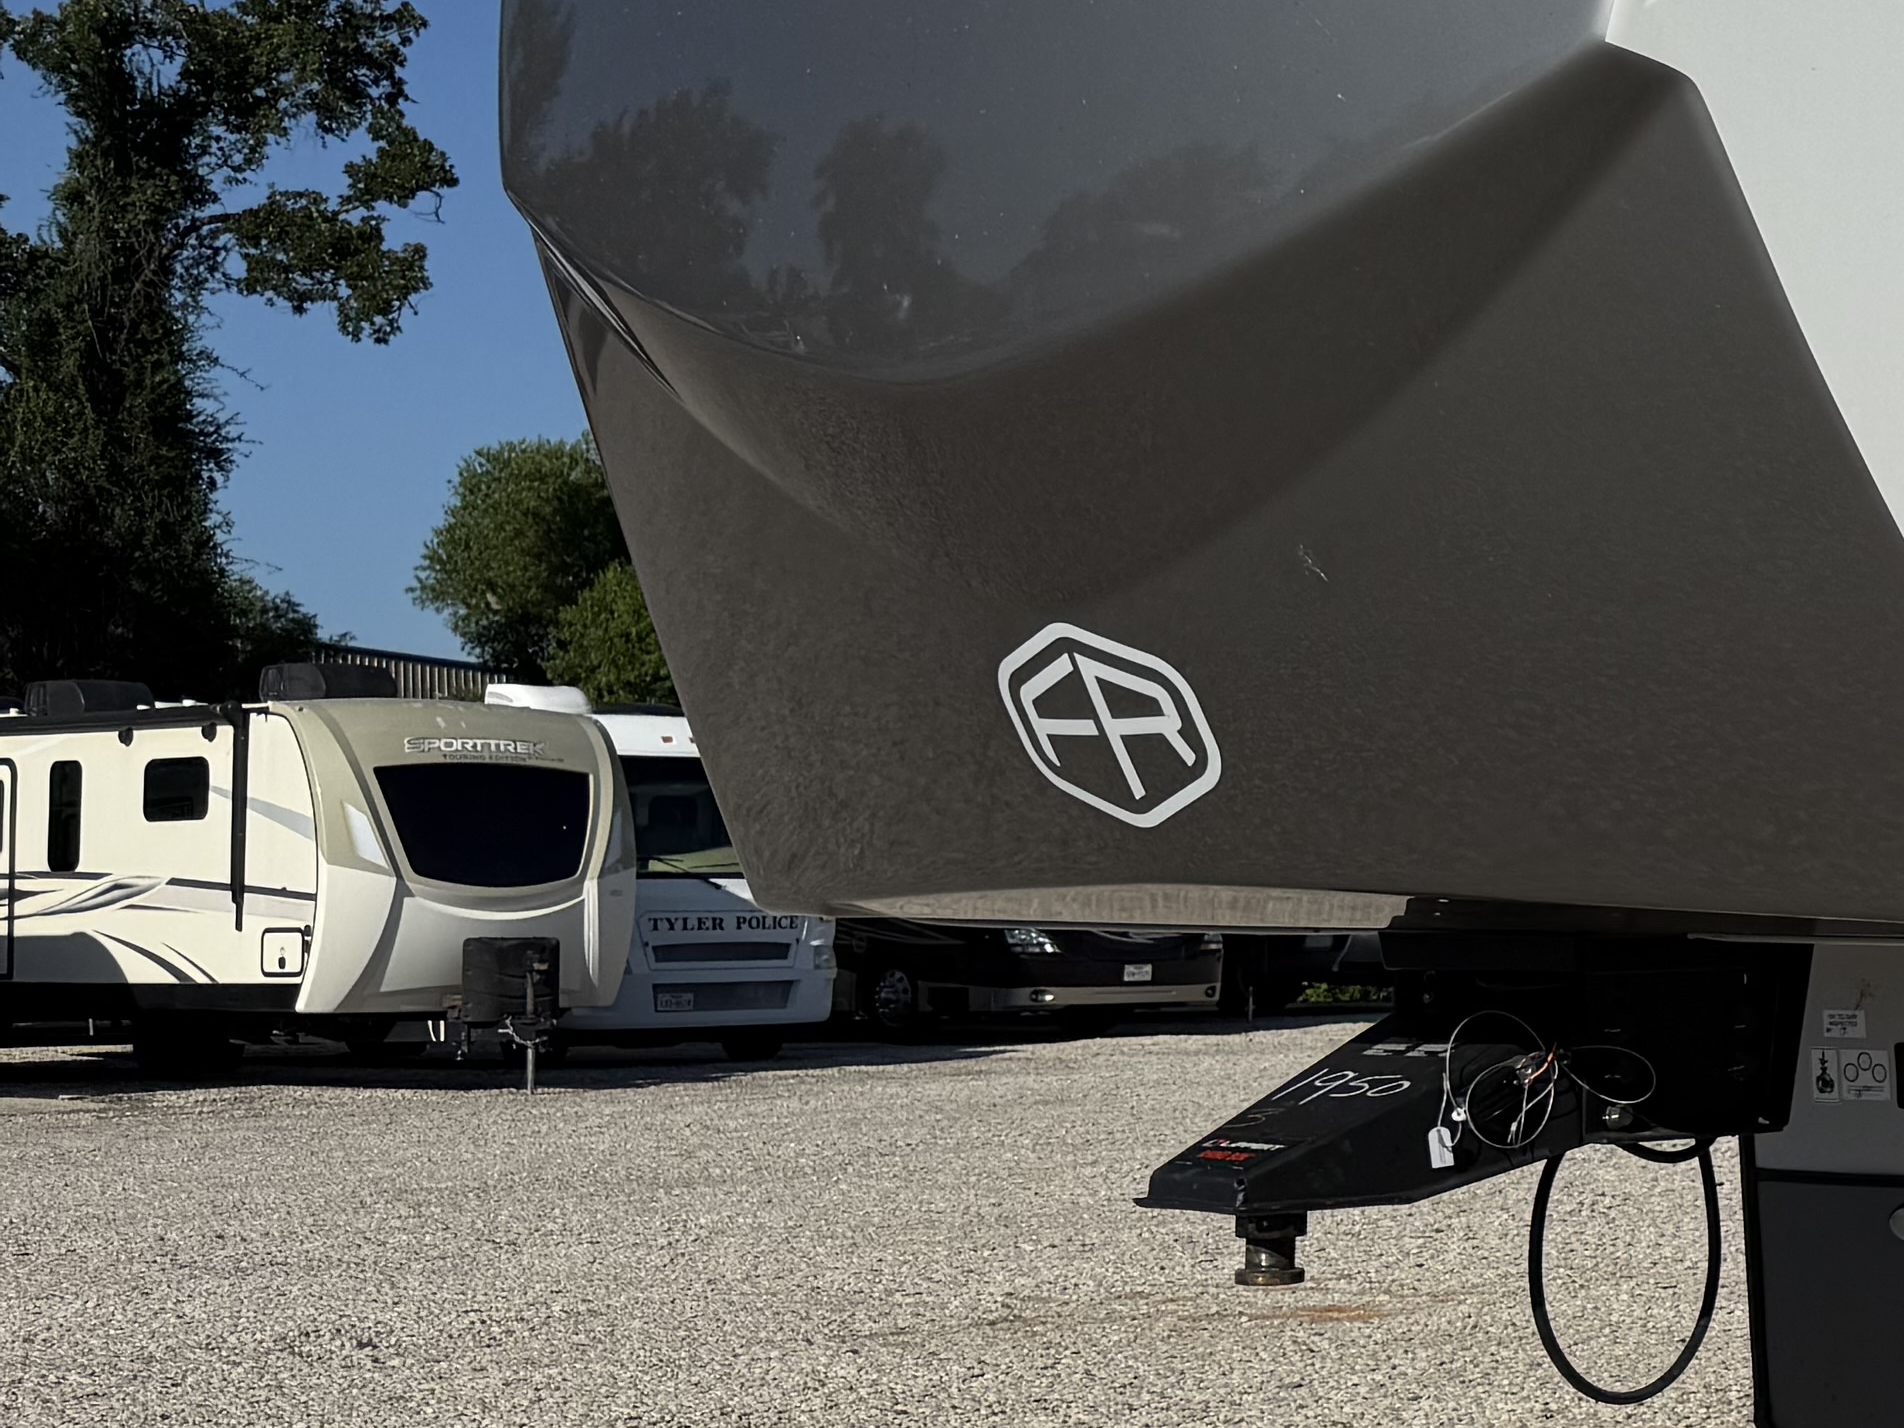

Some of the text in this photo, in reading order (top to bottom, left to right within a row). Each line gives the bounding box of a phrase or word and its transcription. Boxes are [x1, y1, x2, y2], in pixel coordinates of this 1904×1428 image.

[404, 737, 546, 755] SPORTTREK
[648, 915, 800, 932] TYLER POLICE
[1271, 1068, 1412, 1105] 1950
